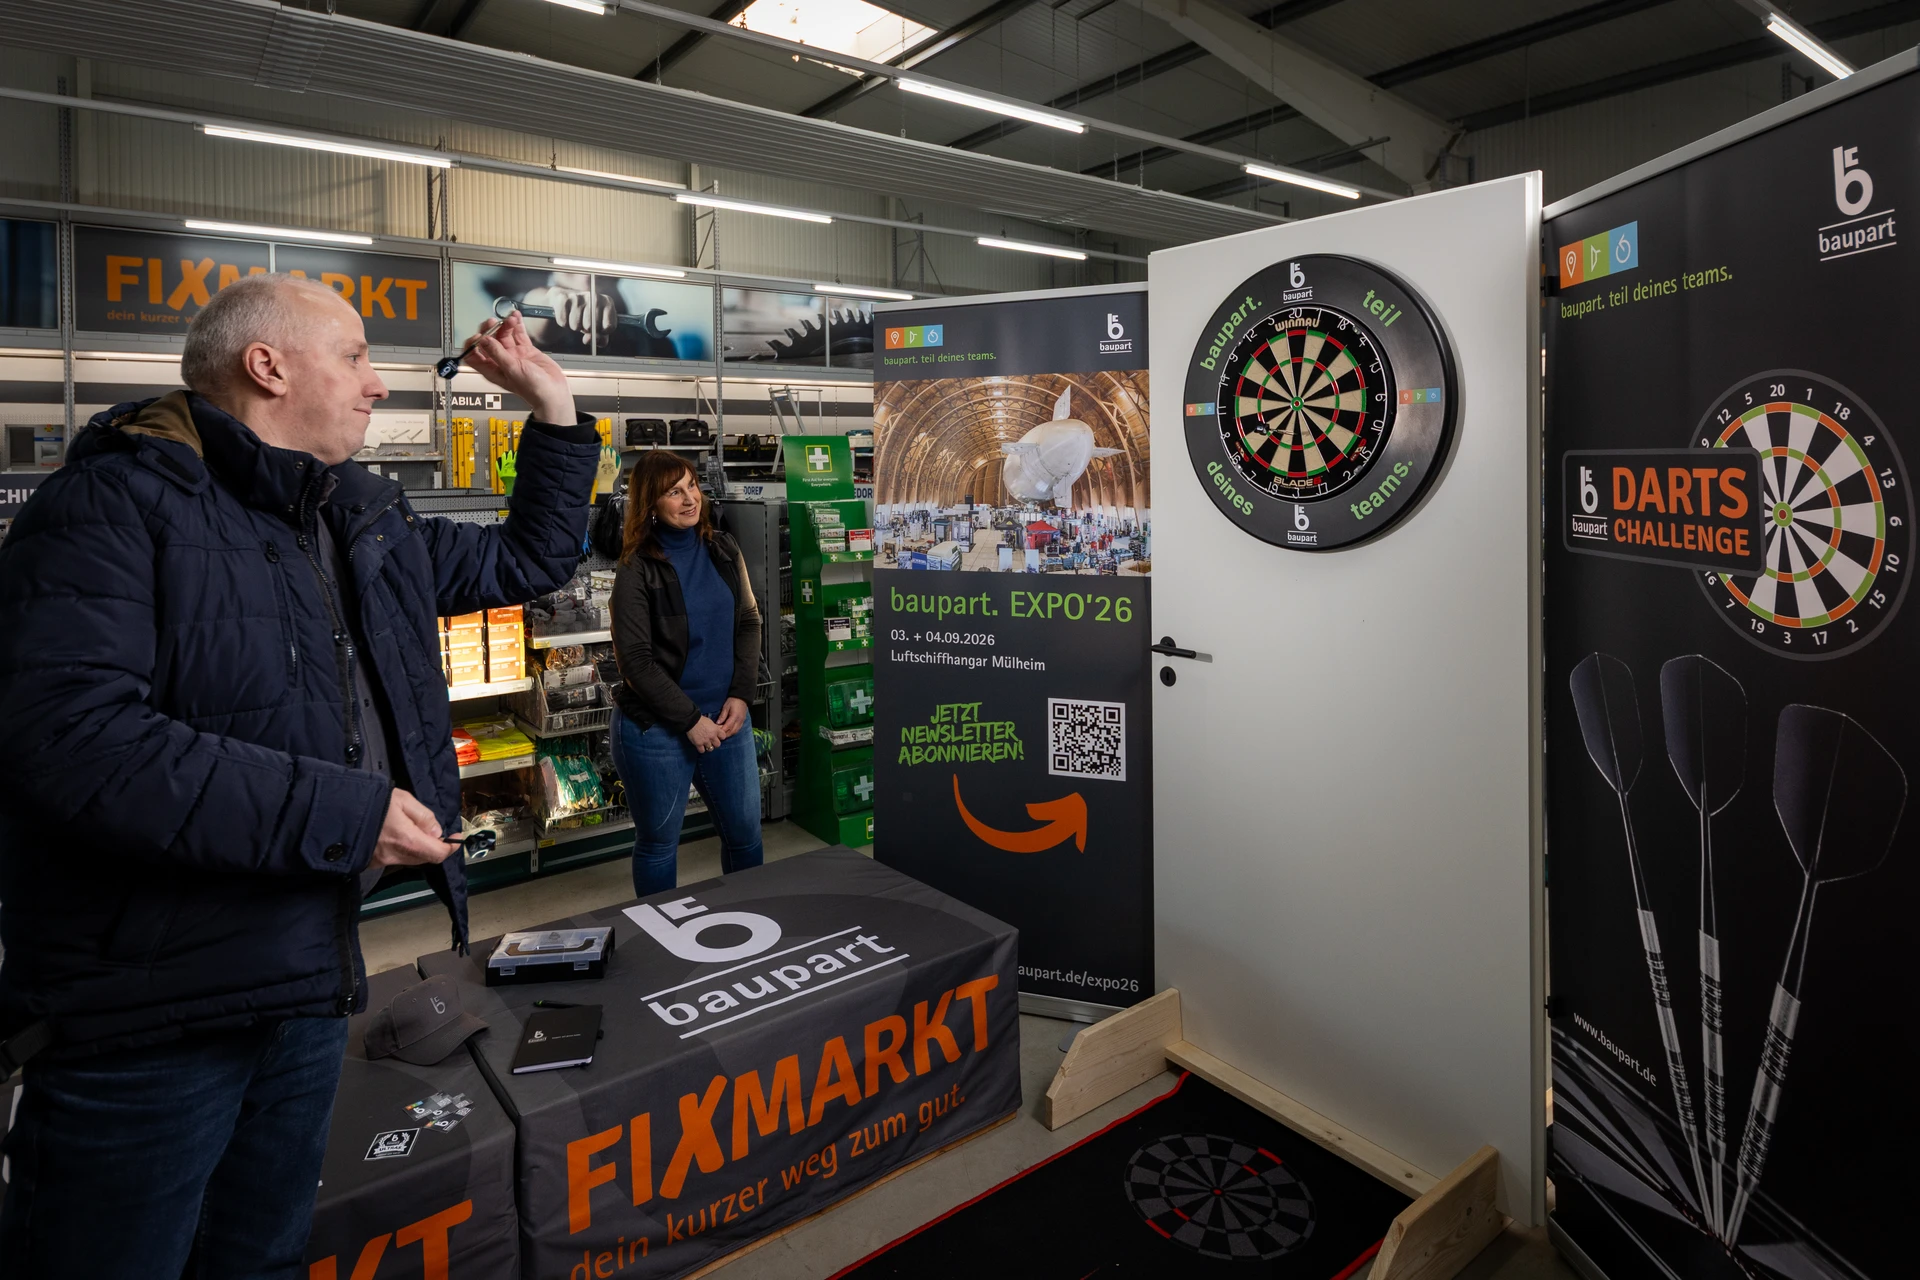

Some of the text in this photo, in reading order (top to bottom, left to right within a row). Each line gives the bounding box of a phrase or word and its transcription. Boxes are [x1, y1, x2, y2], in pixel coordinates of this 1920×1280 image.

[1819, 217, 1896, 253] baupart
[106, 255, 427, 320] FIXKT
[1283, 289, 1313, 301] baupart
[1561, 265, 1733, 319] baupart. teil deines teams.
[107, 309, 136, 321] dein
[1362, 289, 1402, 327] teil
[1200, 296, 1262, 371] baupart.
[1100, 341, 1132, 352] baupart
[884, 351, 997, 366] baupart. teil deines teams.
[1744, 392, 1753, 405] 5
[1770, 383, 1785, 397] 20
[1806, 388, 1813, 401] 1
[440, 396, 482, 406] SABILA
[1716, 408, 1732, 425] 12
[1833, 402, 1851, 421] 18
[1863, 434, 1876, 447] 4
[1207, 461, 1254, 515] deines
[1879, 467, 1896, 489] 13
[0, 488, 37, 504] CHU
[743, 485, 759, 495] DORE
[1350, 461, 1413, 520] teams.
[1612, 467, 1749, 519] DARTS
[1572, 517, 1608, 536] baupart
[1890, 516, 1902, 527] 6
[1287, 533, 1317, 543] baupart
[1614, 518, 1750, 557] CHALLENGE
[1885, 553, 1900, 574] 10
[891, 587, 1133, 623] baupart. EXPO'26
[1725, 598, 1735, 609] 7
[1869, 589, 1887, 610] 15
[1751, 618, 1765, 634] 19
[1845, 619, 1859, 633] 2
[890, 629, 996, 646] 03. + 04.09.2026
[1783, 631, 1791, 645] 3
[1812, 630, 1829, 646] 17
[891, 650, 1046, 671] Luftschiffhangar Mülheim
[930, 702, 982, 724] JETZT
[901, 721, 1019, 744] NEWSLETTER
[898, 740, 1025, 767] ABONNIEREN!
[648, 934, 896, 1026] baupart
[1018, 965, 1139, 992] aupart.de/expo26
[1573, 1012, 1657, 1087] www.baupart.de
[566, 974, 999, 1235] FIXMARKT
[569, 1083, 965, 1280] dein kurzer weg zum gut.
